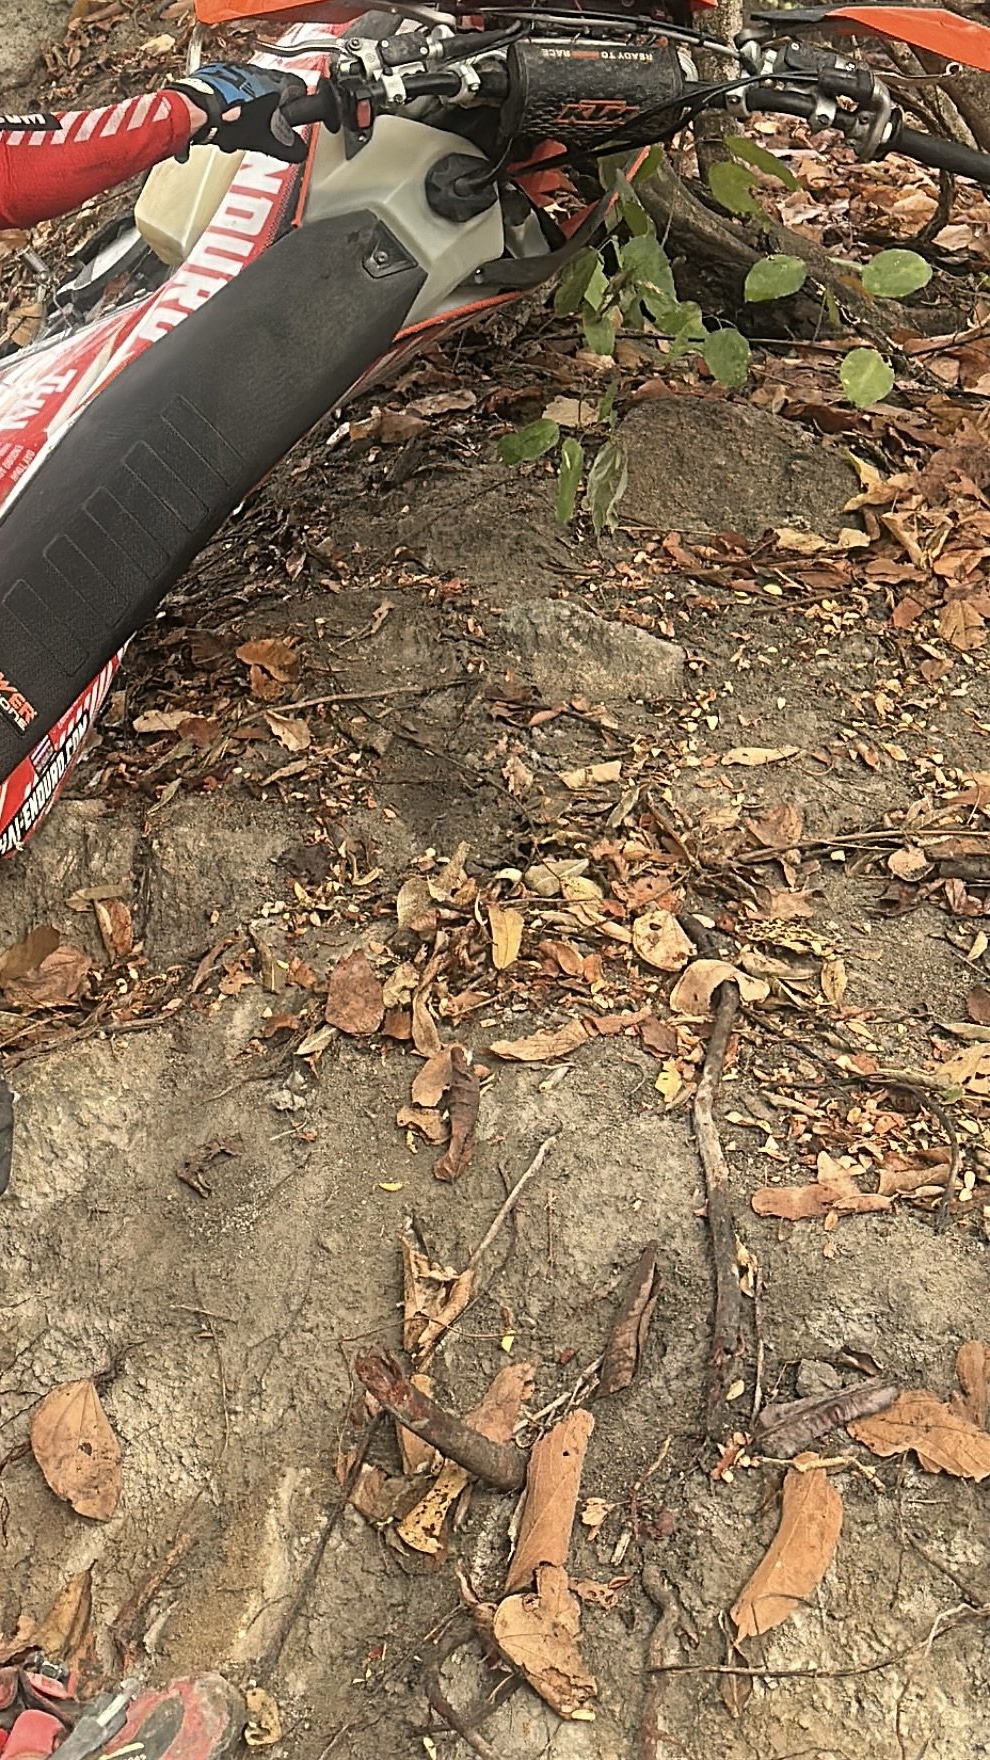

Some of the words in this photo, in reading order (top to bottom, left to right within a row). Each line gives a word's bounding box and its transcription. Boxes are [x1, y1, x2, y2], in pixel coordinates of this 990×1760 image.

[542, 48, 571, 58] RACE
[601, 51, 616, 61] TO
[617, 51, 653, 63] READY
